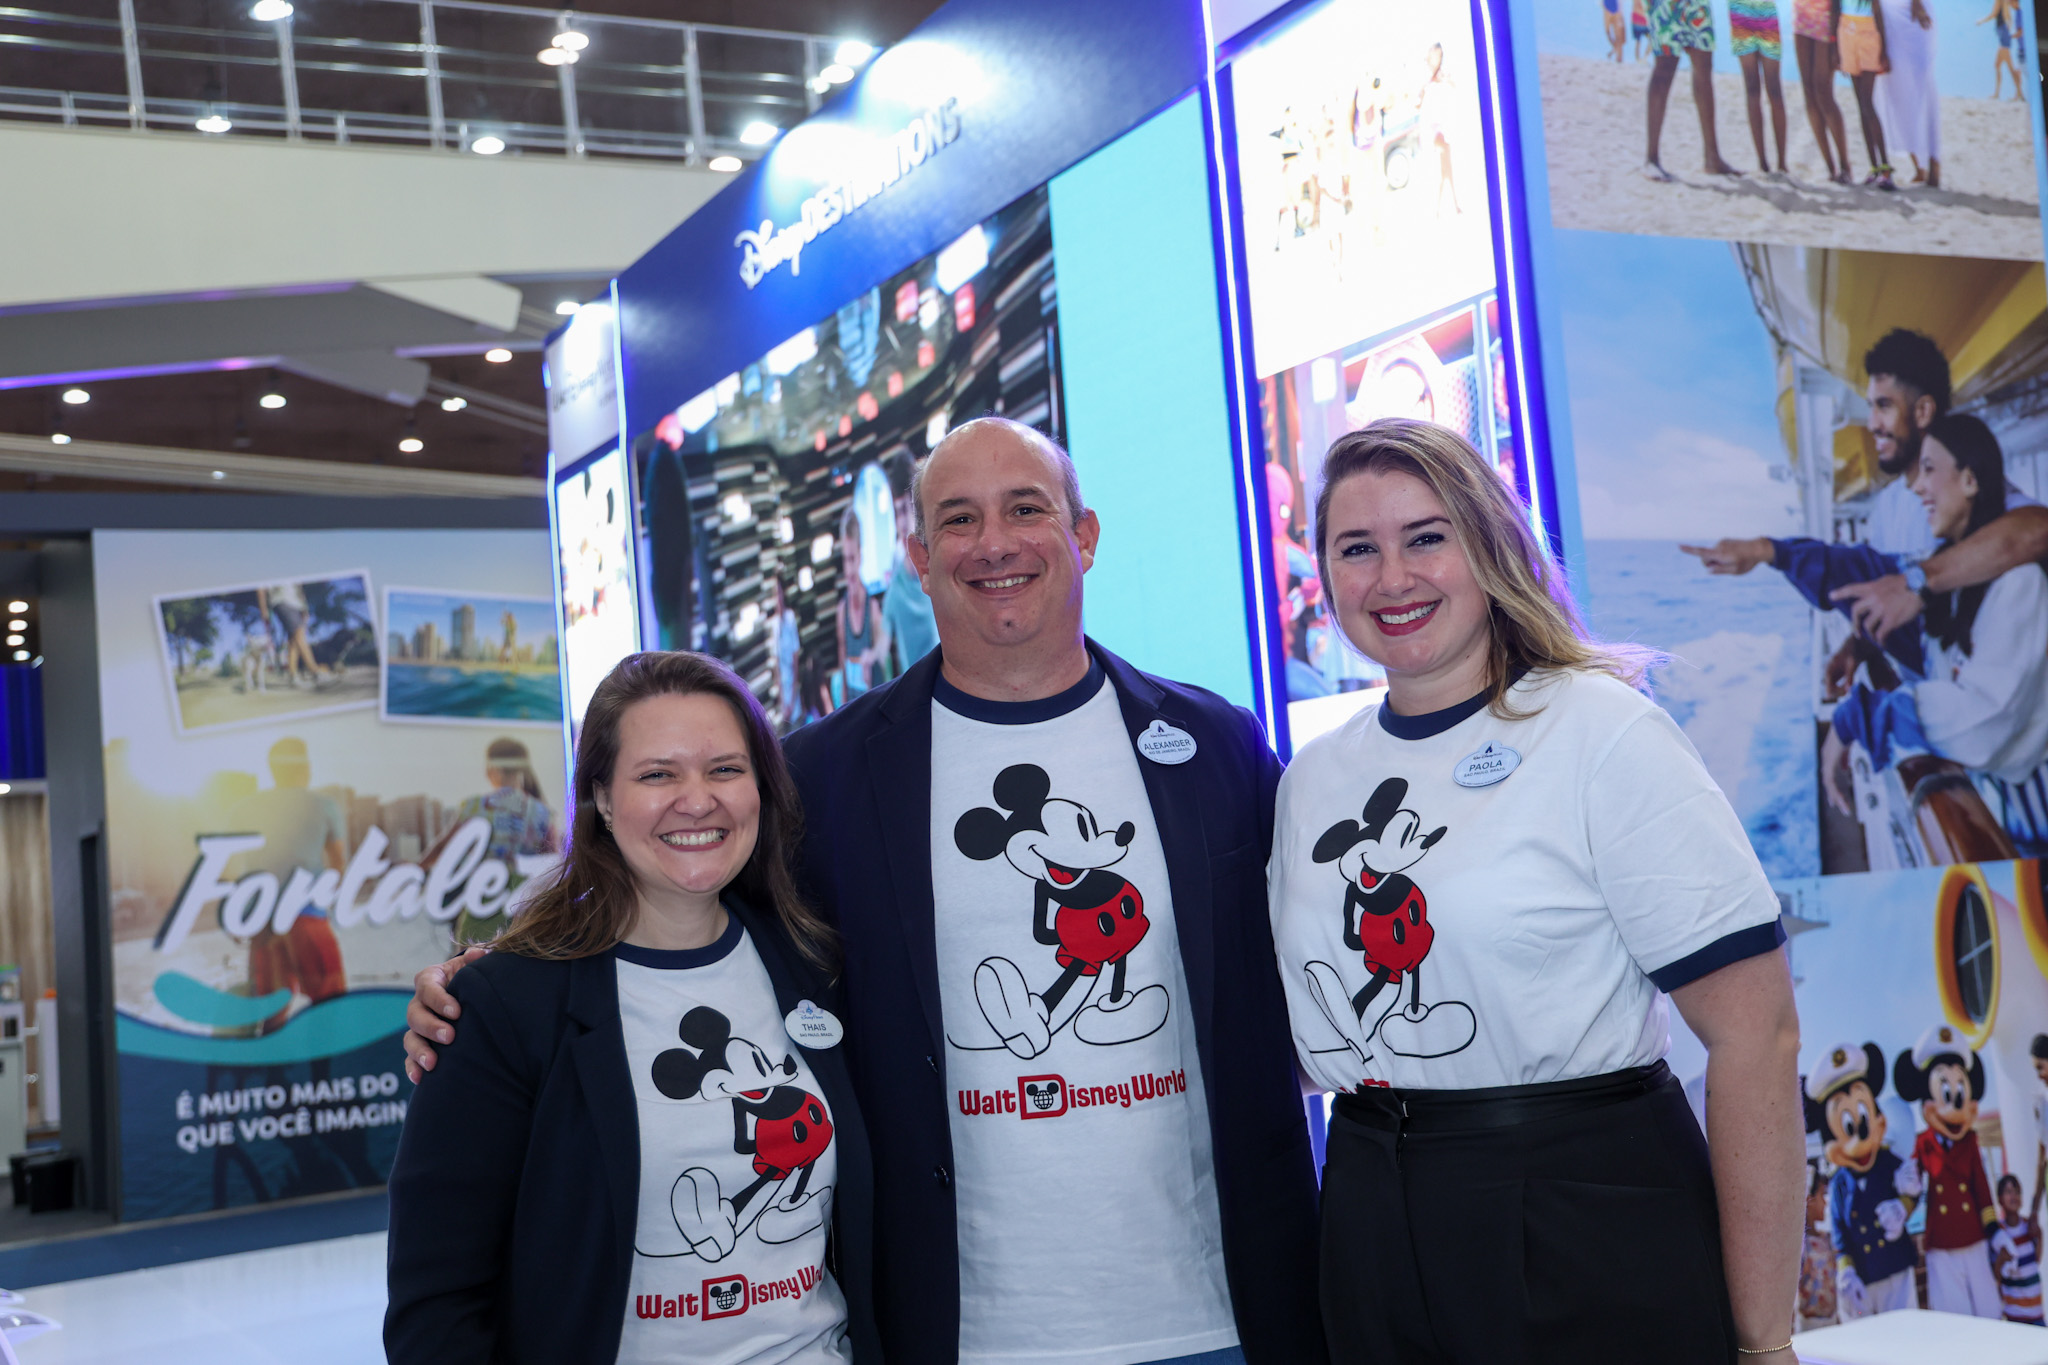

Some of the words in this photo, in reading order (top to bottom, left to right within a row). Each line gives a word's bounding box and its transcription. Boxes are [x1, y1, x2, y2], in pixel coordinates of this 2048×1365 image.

[801, 97, 961, 243] DESTIONS
[1144, 738, 1192, 751] ALEXANDER
[1469, 759, 1503, 772] PAOLA
[801, 1023, 827, 1031] THAIS
[176, 1090, 195, 1119] É
[200, 1085, 287, 1118] MUITO
[291, 1075, 356, 1106] MAIS
[359, 1072, 399, 1098] DO
[958, 1089, 1017, 1116] Walt
[176, 1120, 236, 1153] QUE
[238, 1107, 313, 1142] VOCÊ
[636, 1293, 699, 1320] Walt
